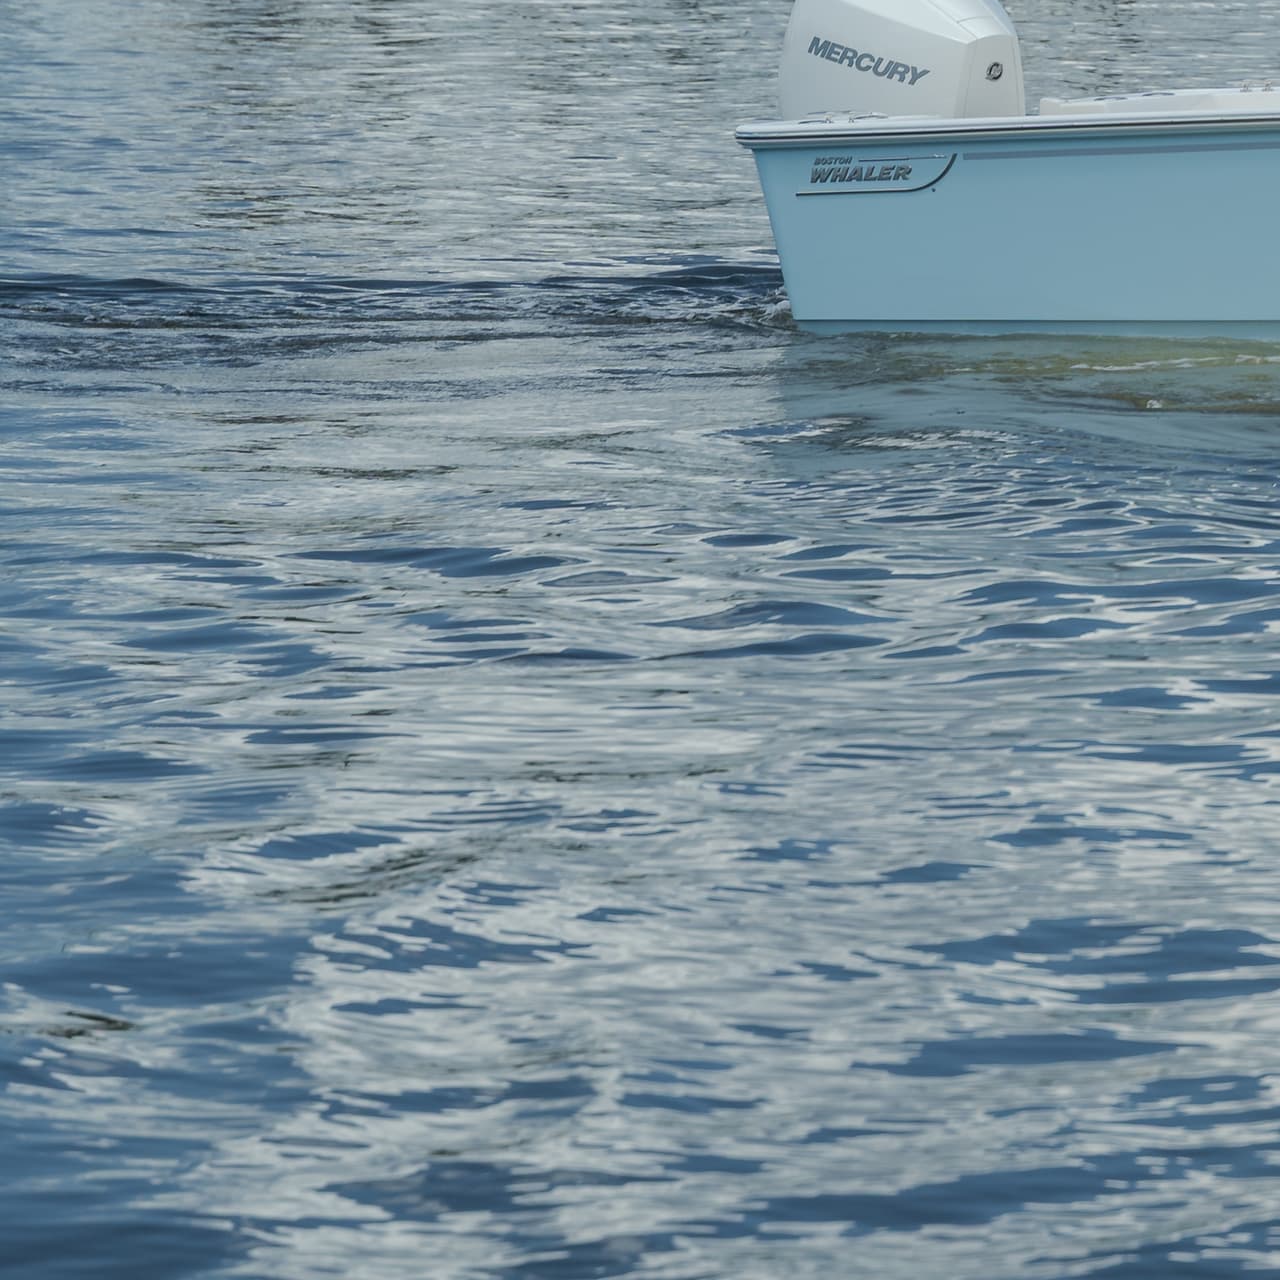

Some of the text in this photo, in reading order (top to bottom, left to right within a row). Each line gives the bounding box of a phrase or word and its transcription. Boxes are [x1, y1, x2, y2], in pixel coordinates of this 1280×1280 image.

[807, 36, 931, 86] MERCURY
[813, 156, 853, 166] BOSTON
[810, 165, 912, 184] WHALER
